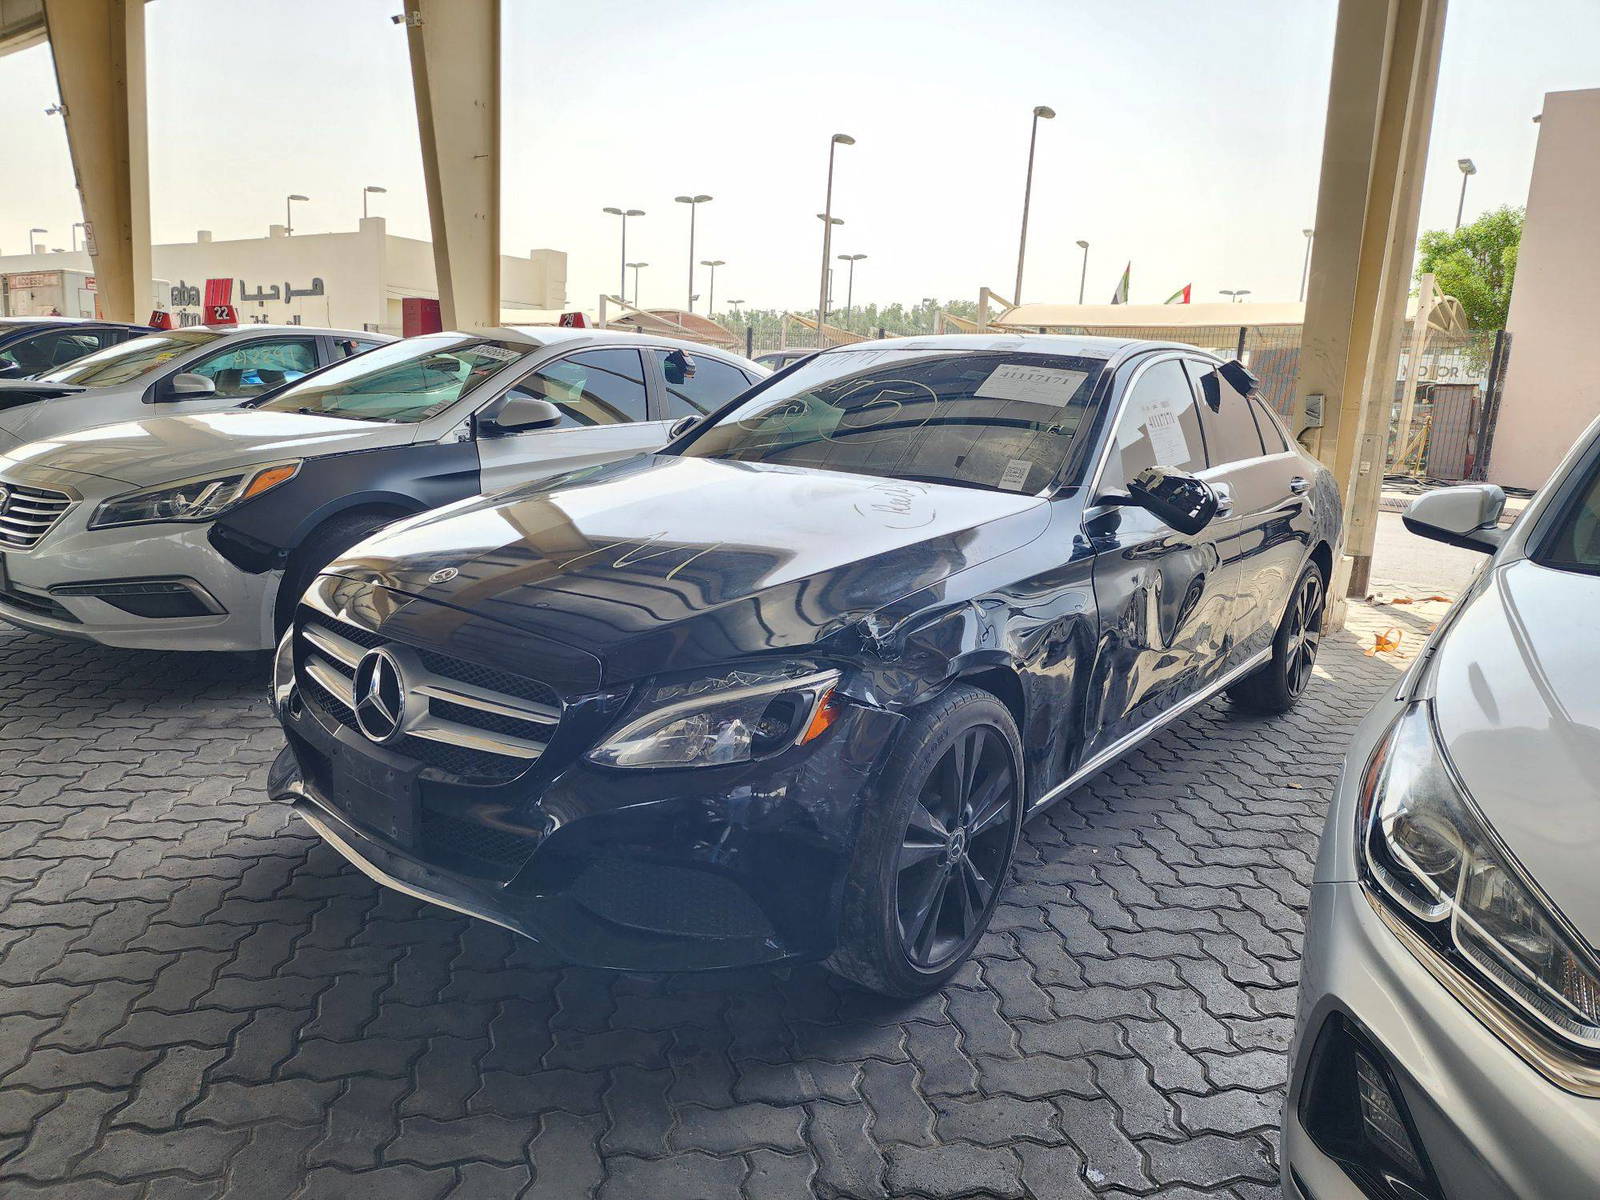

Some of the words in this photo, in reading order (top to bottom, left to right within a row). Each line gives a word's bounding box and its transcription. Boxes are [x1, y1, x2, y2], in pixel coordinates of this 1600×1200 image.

[240, 277, 324, 307] مرحبا
[214, 306, 231, 320] 22
[564, 314, 575, 328] 29
